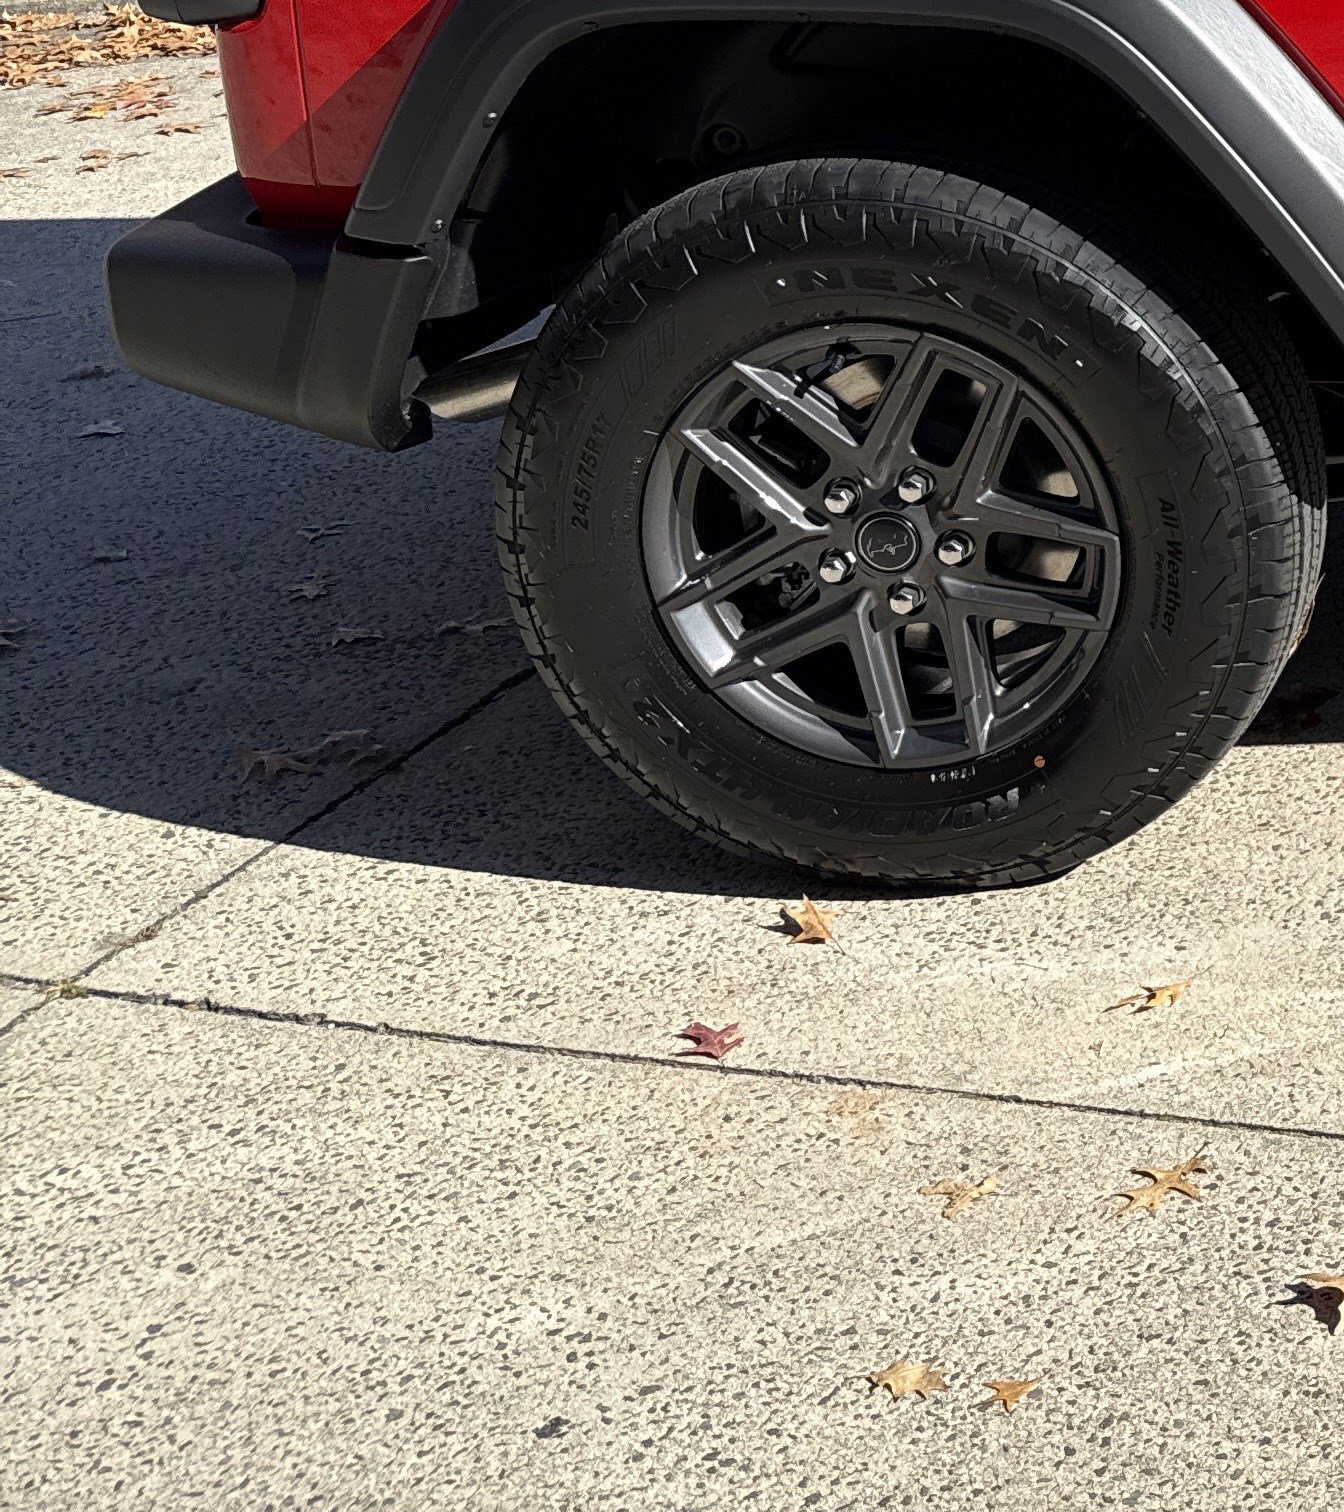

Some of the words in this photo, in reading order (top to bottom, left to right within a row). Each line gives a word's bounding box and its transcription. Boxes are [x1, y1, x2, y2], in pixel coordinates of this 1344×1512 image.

[794, 267, 1070, 361] NEXEN
[571, 412, 613, 532] 245/75R17
[1149, 551, 1165, 631] Performance
[1157, 496, 1184, 638] All-Weather
[769, 785, 1020, 838] ROADIAN
